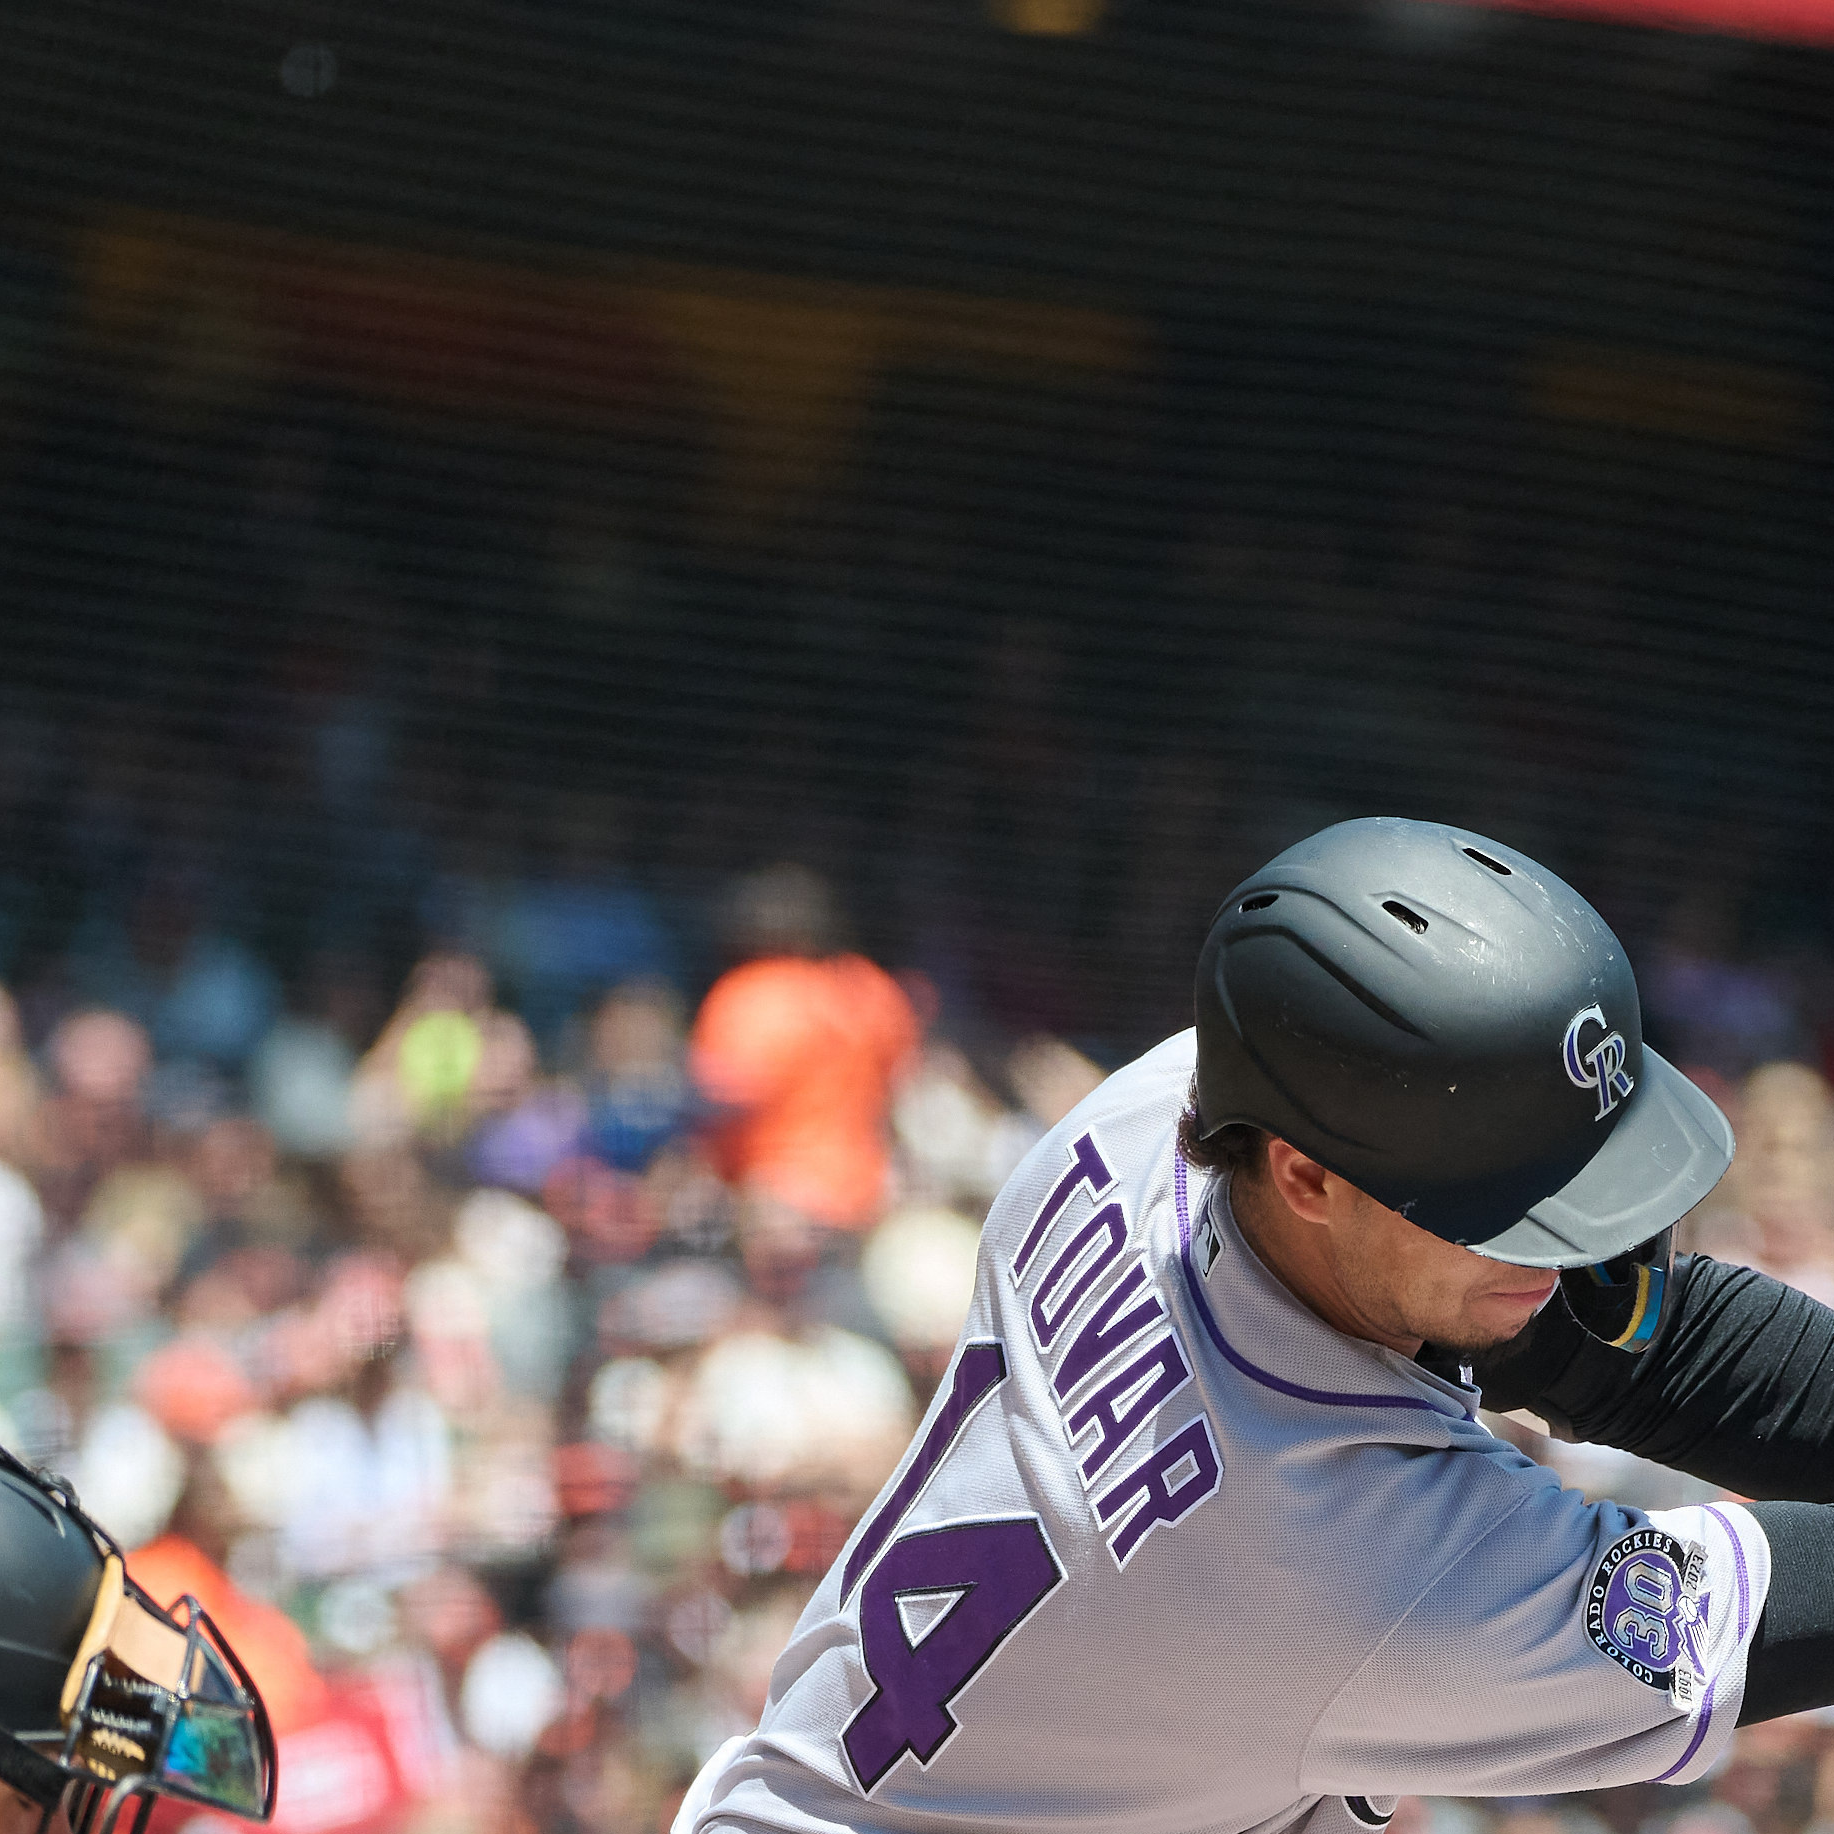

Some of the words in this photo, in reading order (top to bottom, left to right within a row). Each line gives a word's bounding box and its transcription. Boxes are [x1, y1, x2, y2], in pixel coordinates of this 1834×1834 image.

[1563, 1001, 1634, 1121] CR
[1009, 1124, 1224, 1572] TOVAR
[837, 1336, 1070, 1800] 14
[1601, 1532, 1673, 1577] ROCKIES
[1685, 1551, 1705, 1592] 2023
[1589, 1584, 1653, 1685] COLORADO
[1613, 1558, 1674, 1661] 30
